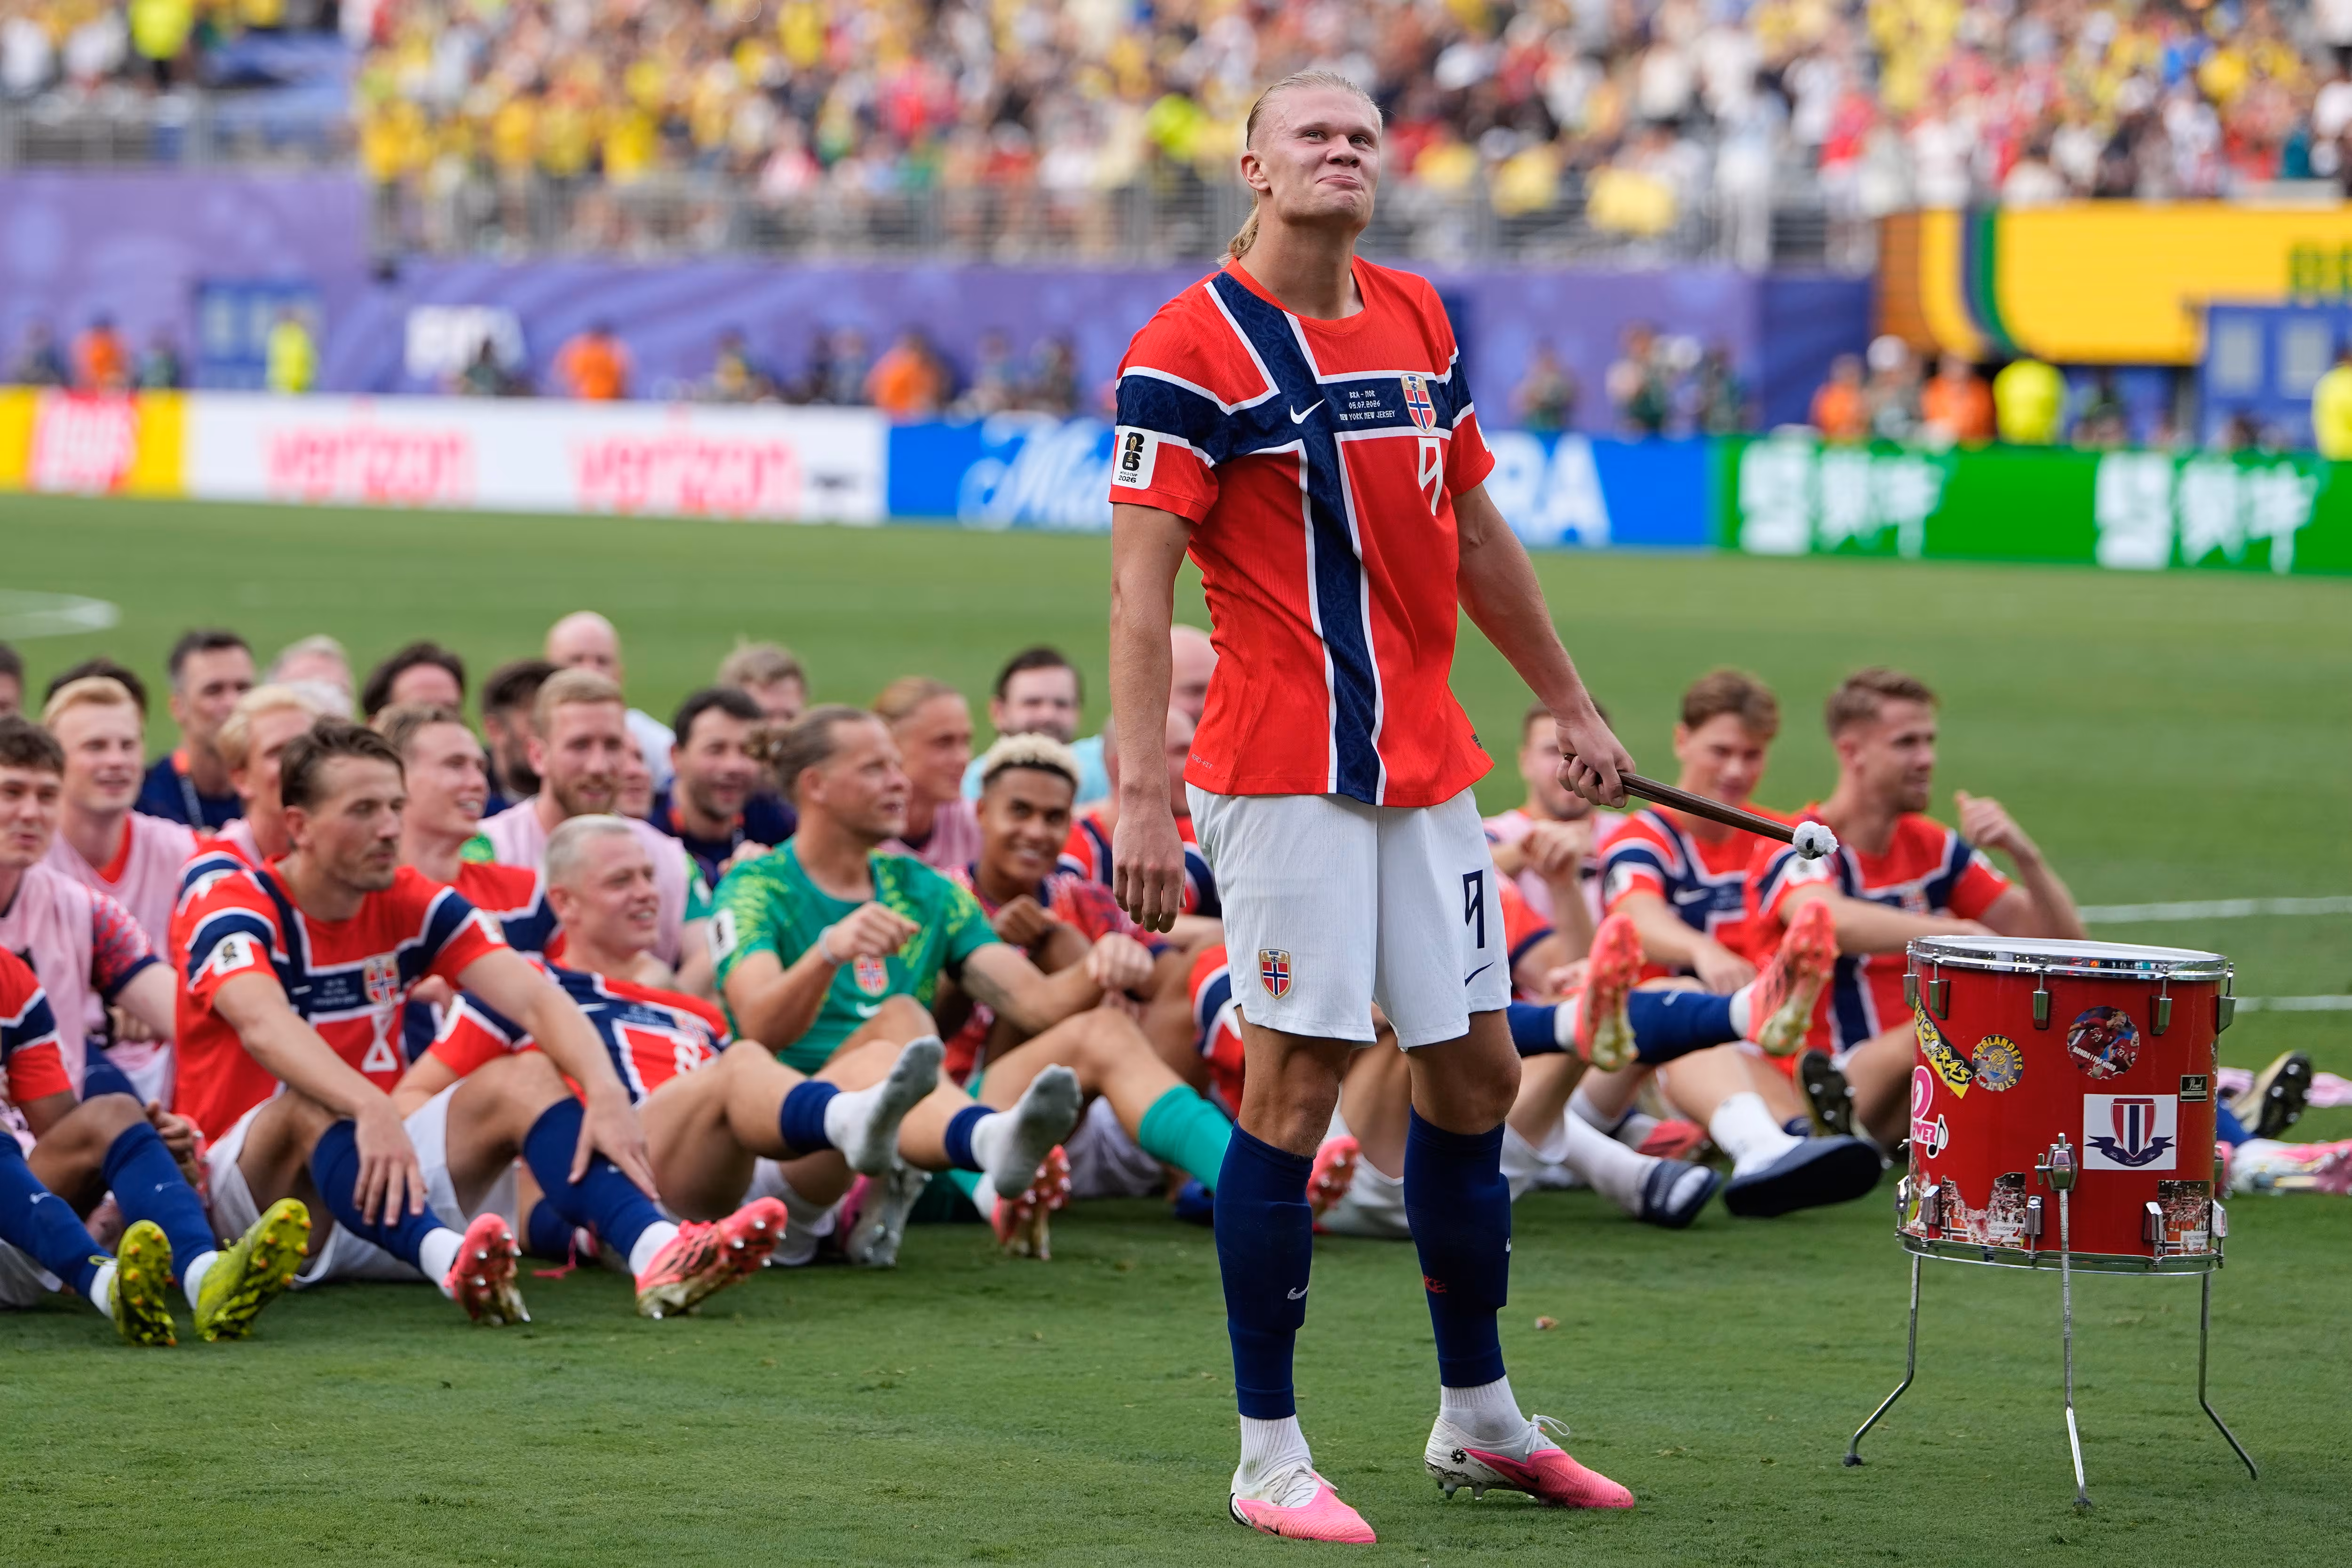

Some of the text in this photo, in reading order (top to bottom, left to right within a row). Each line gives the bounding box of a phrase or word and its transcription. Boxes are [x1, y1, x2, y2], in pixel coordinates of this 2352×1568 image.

[1349, 400, 1381, 409] 05.07.2026
[1349, 412, 1364, 421] YORK
[1376, 410, 1395, 419] JERSEY
[1417, 436, 1443, 516] 9
[1462, 870, 1485, 949] 9
